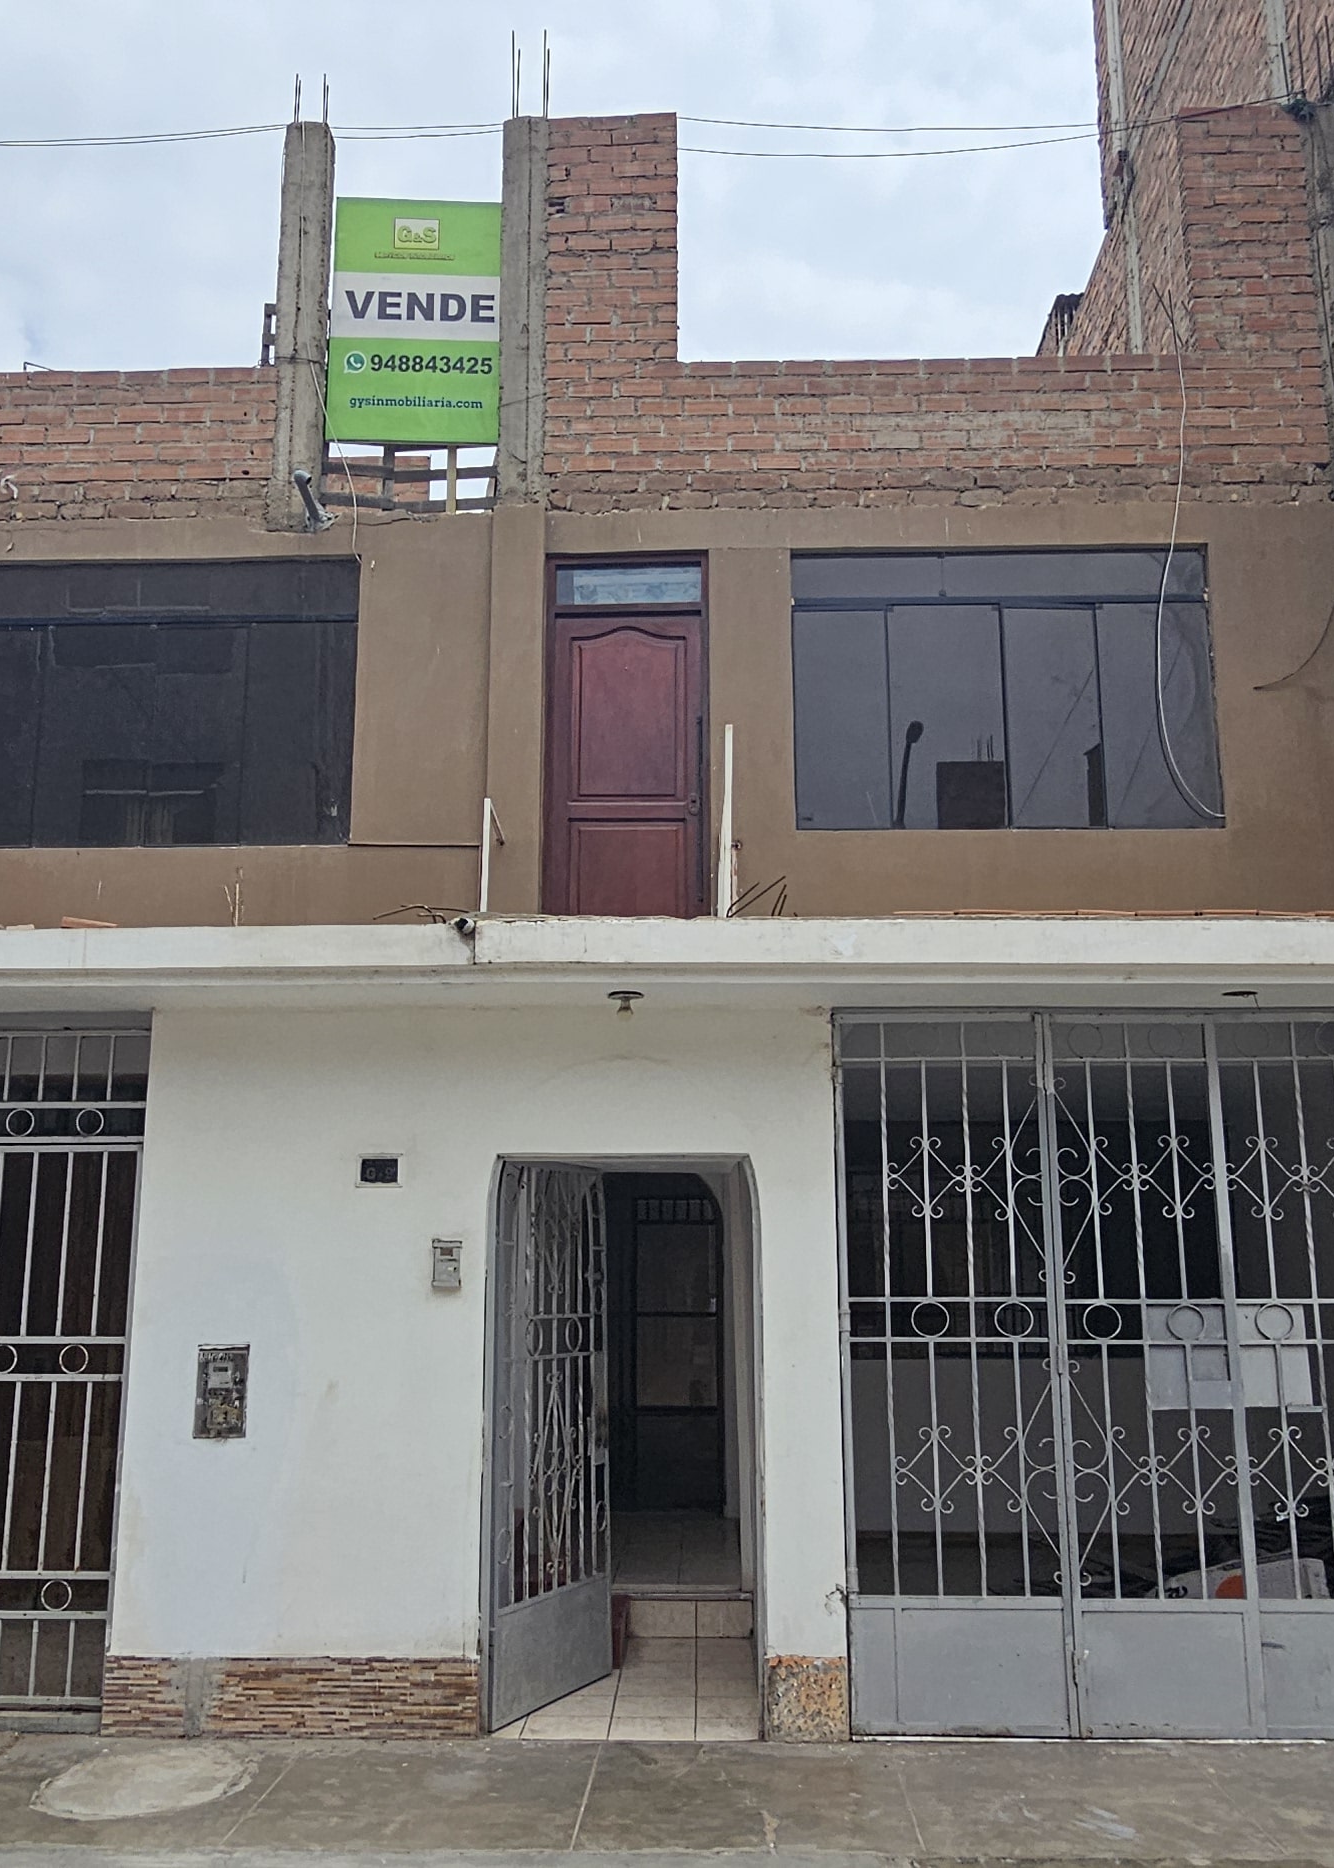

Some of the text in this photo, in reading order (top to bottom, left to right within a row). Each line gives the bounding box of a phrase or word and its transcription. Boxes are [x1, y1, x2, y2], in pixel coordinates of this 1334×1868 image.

[397, 225, 437, 244] G&S
[345, 290, 496, 323] VENDE
[370, 354, 493, 375] 948843425
[349, 394, 483, 410] gysinmobiliaria.com
